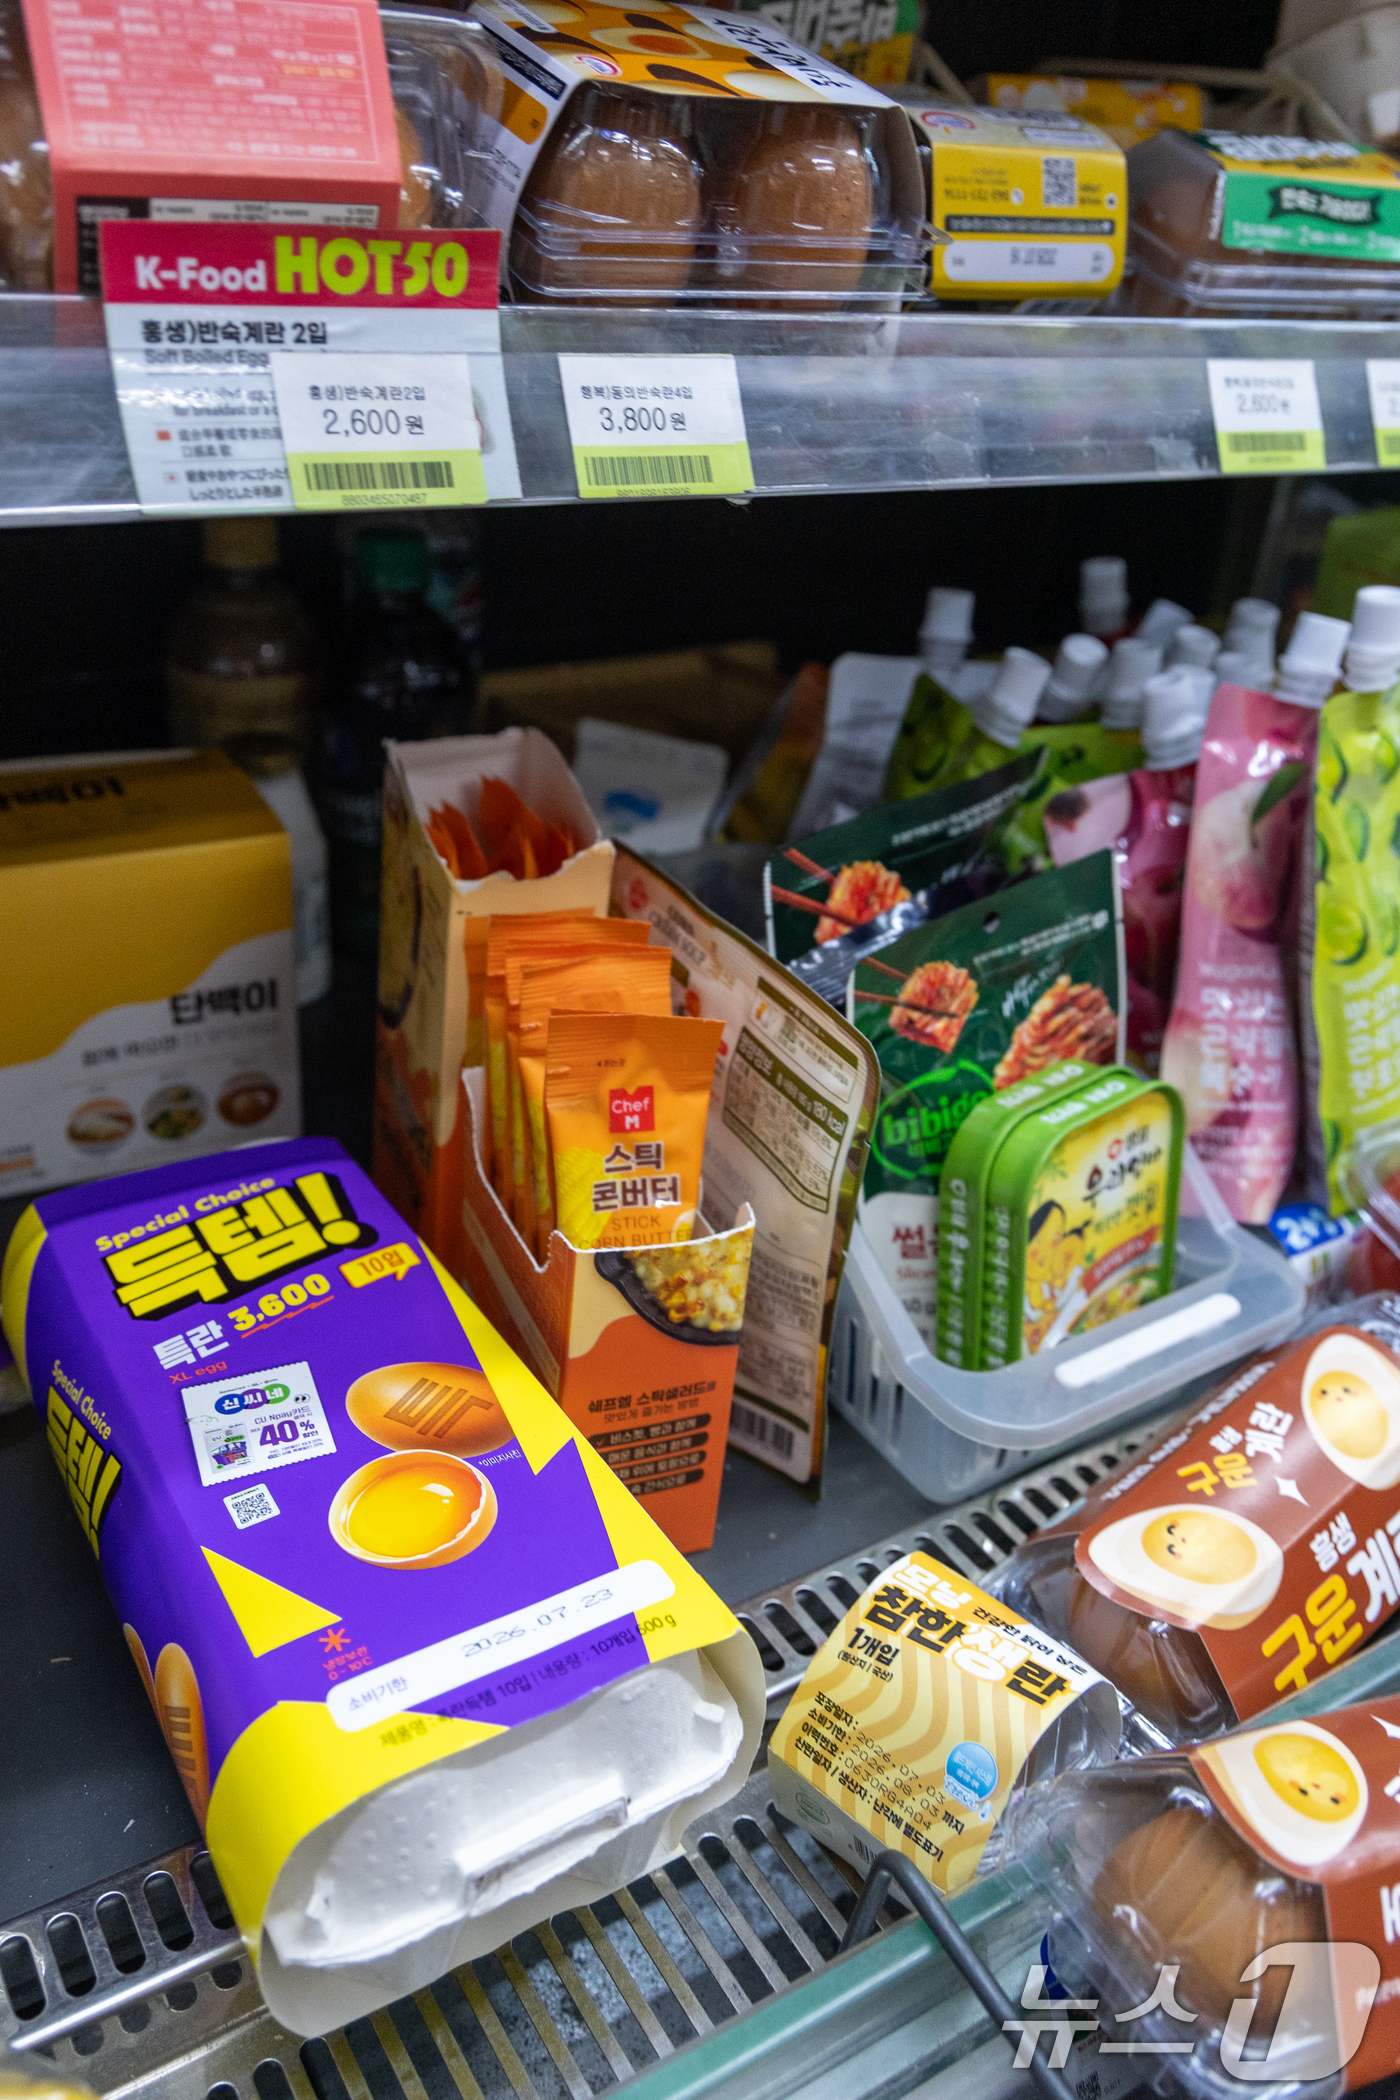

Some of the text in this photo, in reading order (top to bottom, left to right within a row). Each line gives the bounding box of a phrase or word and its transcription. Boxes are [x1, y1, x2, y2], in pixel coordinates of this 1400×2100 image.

[134, 236, 469, 297] K-Food HOT50
[293, 321, 328, 345] 2입
[611, 1097, 651, 1113] Chef
[624, 1114, 640, 1129] M
[603, 1141, 664, 1174] 스틱
[592, 1174, 682, 1213] 콘버터
[95, 1177, 276, 1252] Special Choice
[611, 1214, 661, 1231] STICK
[105, 1171, 362, 1318] 득템!
[578, 1229, 692, 1250] CORN BUTTER
[357, 1248, 407, 1277] 10입
[152, 1272, 331, 1371] 특란 3,600
[168, 1360, 228, 1385] XL egg
[52, 1359, 112, 1441] Special Choice
[254, 1416, 267, 1425] CU
[972, 1606, 1021, 1637] 건강한
[590, 1626, 637, 1658] 10개입
[847, 1627, 901, 1667] 1개입
[348, 1676, 409, 1712] 소비기한
[813, 1690, 854, 1728] 포장일자
[801, 1721, 840, 1758] 이력번호
[807, 1707, 847, 1743] 소비기한
[941, 1809, 965, 1836] 까지
[794, 1735, 833, 1773] 산란일자
[838, 1770, 868, 1801] 생산자
[873, 1798, 904, 1830] 난각에
[902, 1821, 945, 1863] 별도표기
